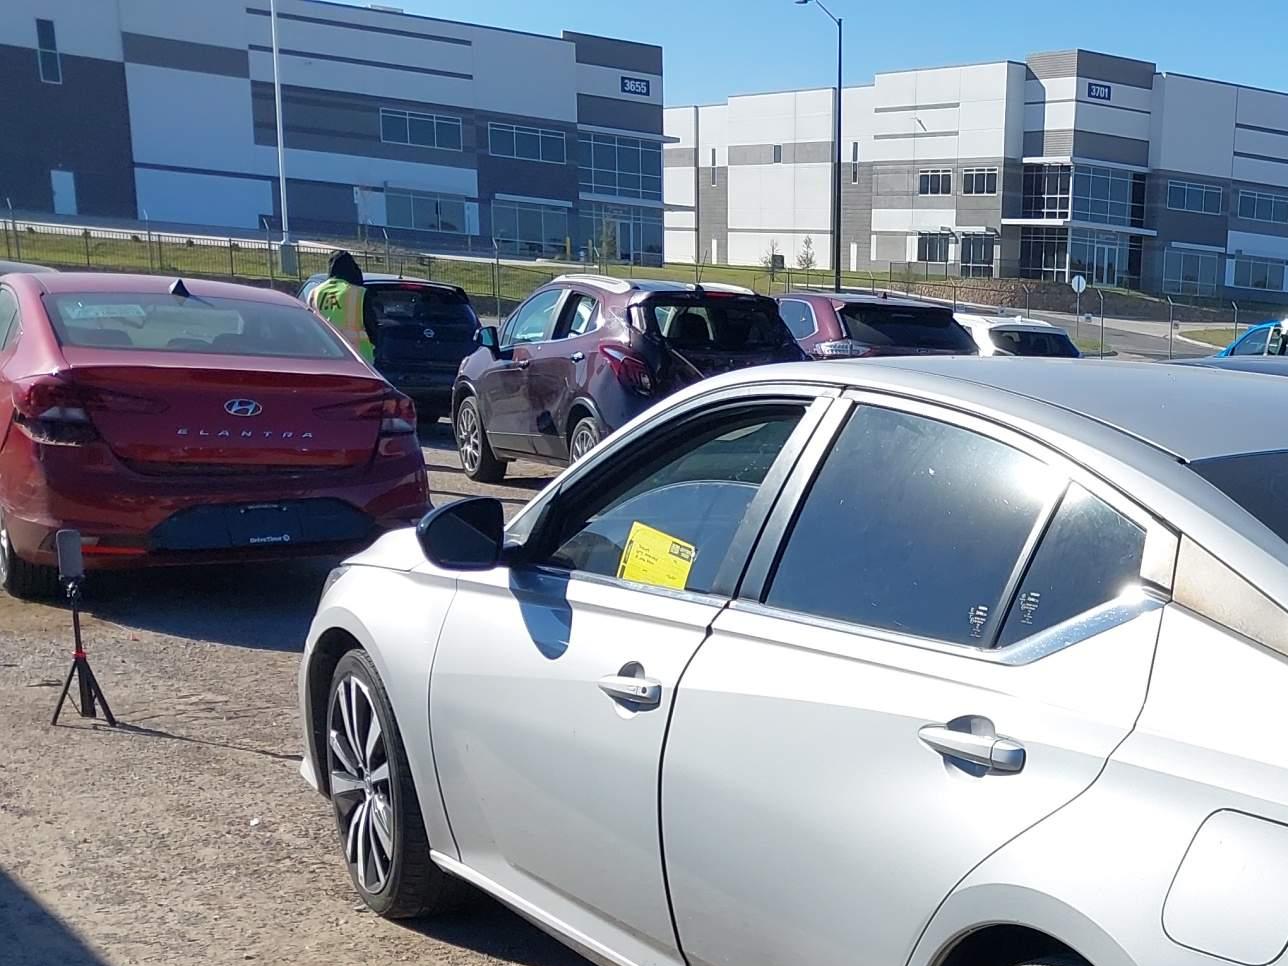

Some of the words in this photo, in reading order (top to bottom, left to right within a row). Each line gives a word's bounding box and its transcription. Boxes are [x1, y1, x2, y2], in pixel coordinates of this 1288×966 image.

[624, 79, 647, 93] 3655
[1091, 85, 1109, 99] 3701
[177, 428, 313, 439] ELANTRA
